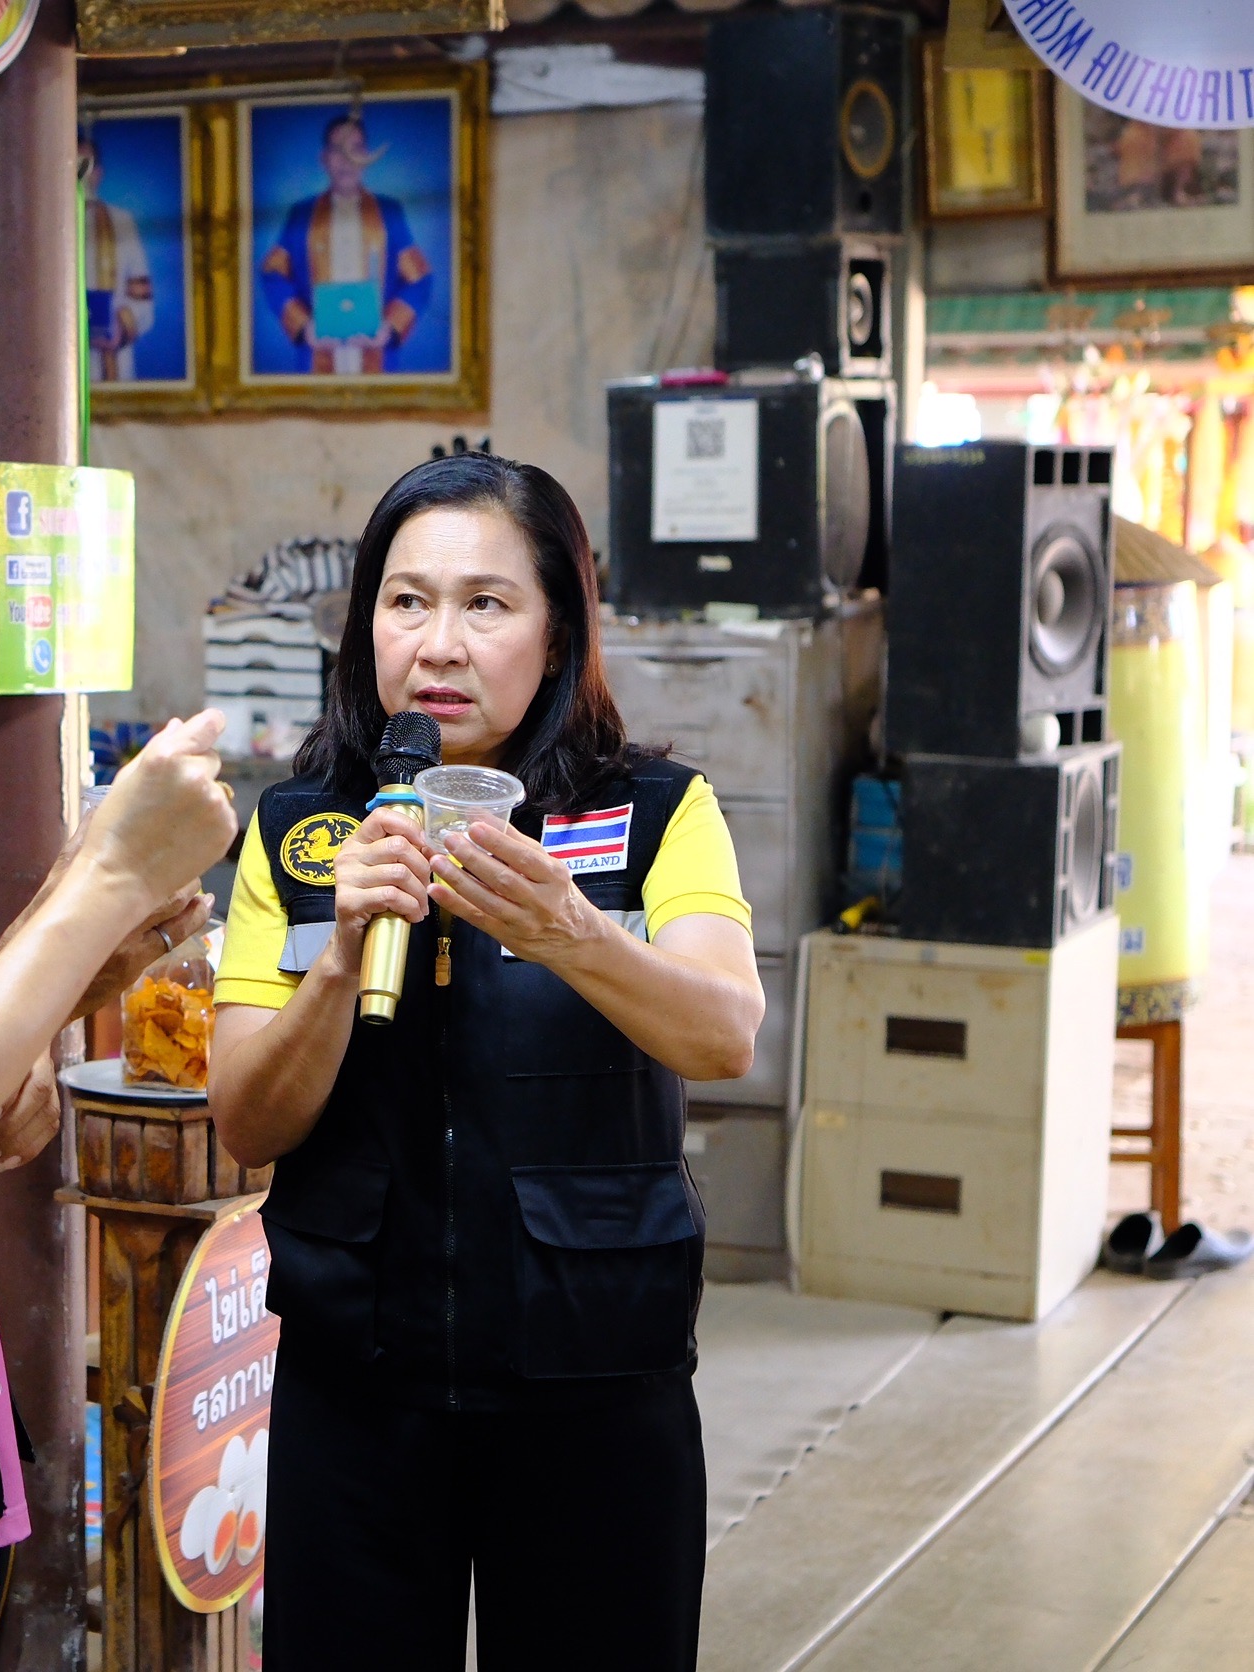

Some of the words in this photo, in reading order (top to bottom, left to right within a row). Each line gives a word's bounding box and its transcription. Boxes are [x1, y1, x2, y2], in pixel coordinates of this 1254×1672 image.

[565, 855, 621, 870] AILAND
[205, 1248, 267, 1344] ไข่เค็
